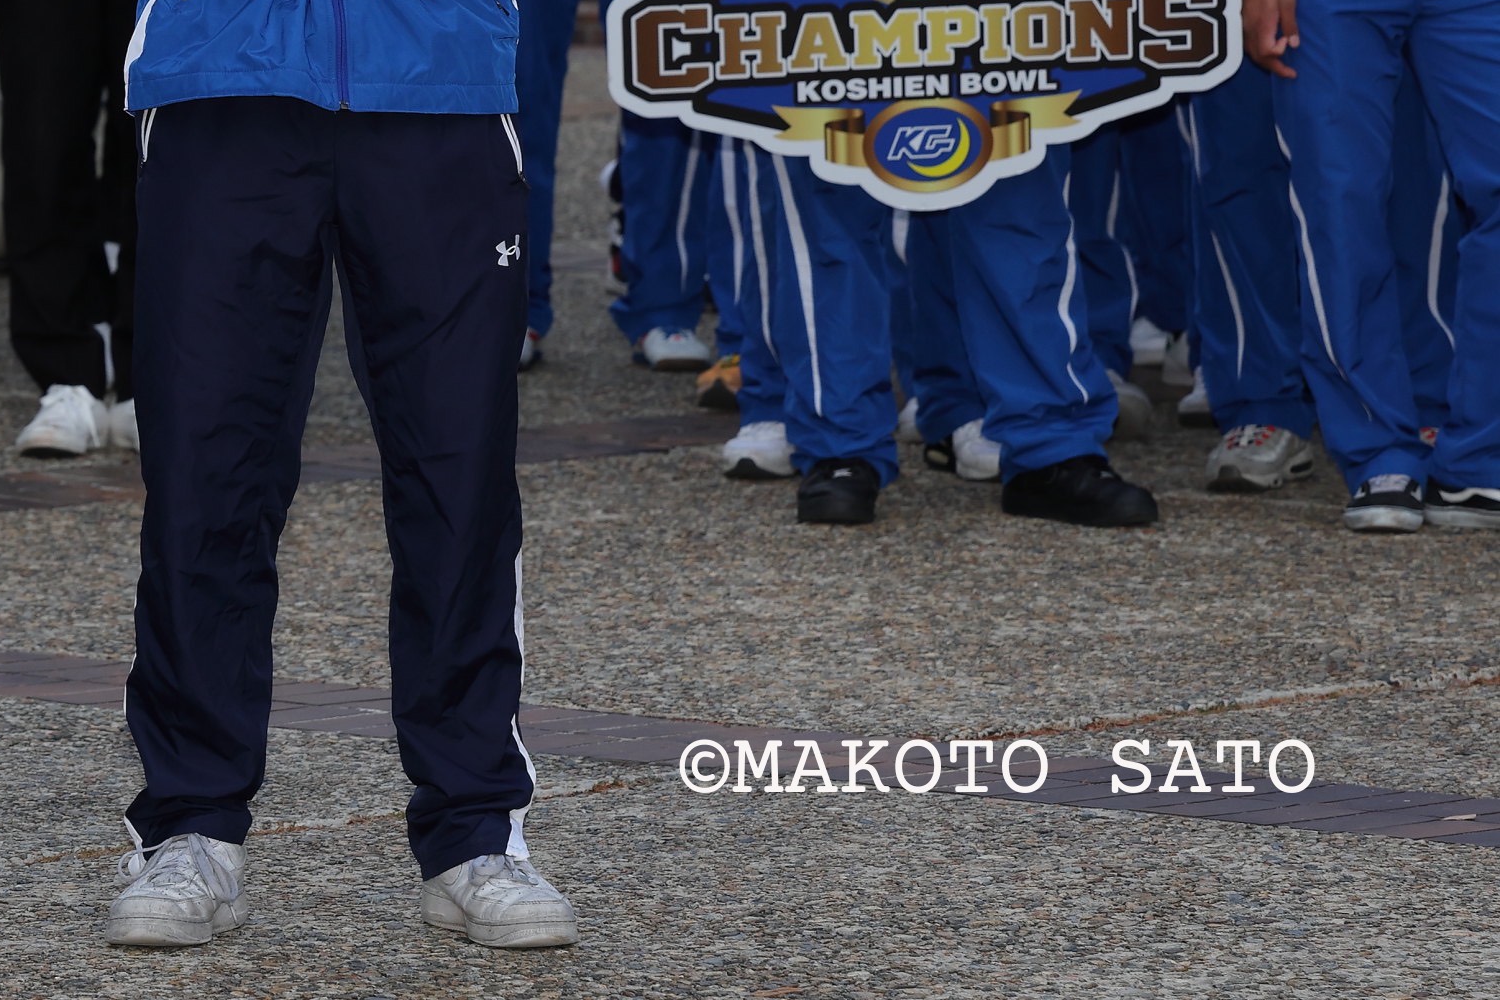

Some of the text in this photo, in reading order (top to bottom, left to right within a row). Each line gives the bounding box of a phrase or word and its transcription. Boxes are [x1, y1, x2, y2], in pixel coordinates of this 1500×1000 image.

[797, 68, 1058, 103] KOSHIEN BOWL
[886, 123, 956, 162] KG
